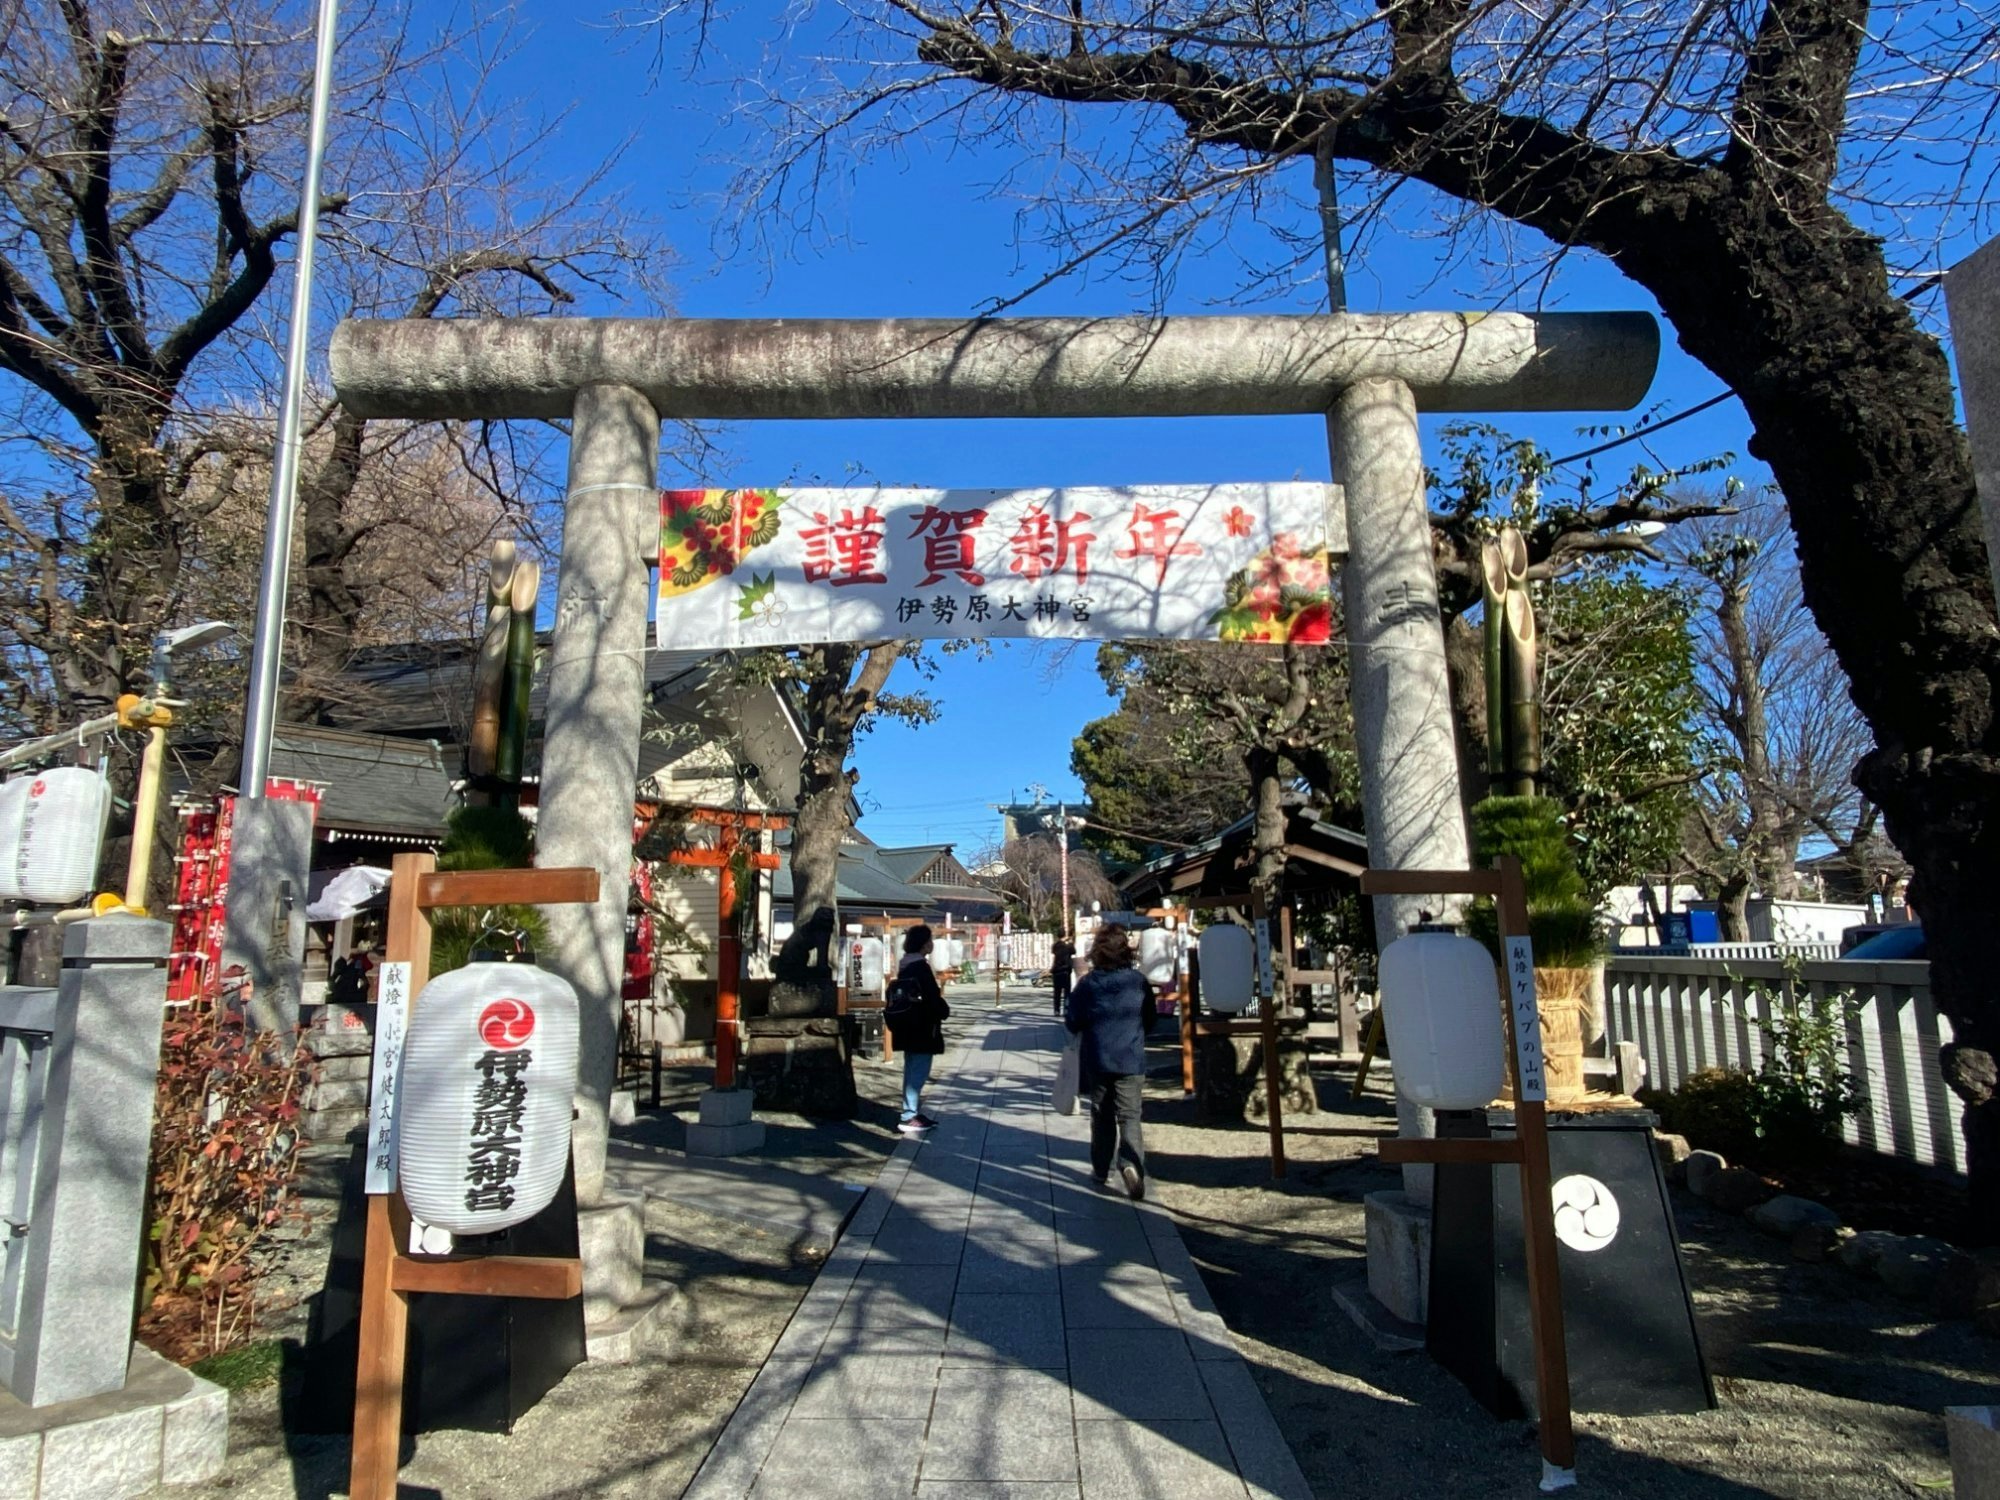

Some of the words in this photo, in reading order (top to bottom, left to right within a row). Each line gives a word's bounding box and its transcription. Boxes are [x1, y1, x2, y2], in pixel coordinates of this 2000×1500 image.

[798, 505, 1202, 588] 謹賀新年
[895, 594, 1094, 624] 伊勢原大神宮
[464, 1049, 532, 1212] 伊勢原大神宮
